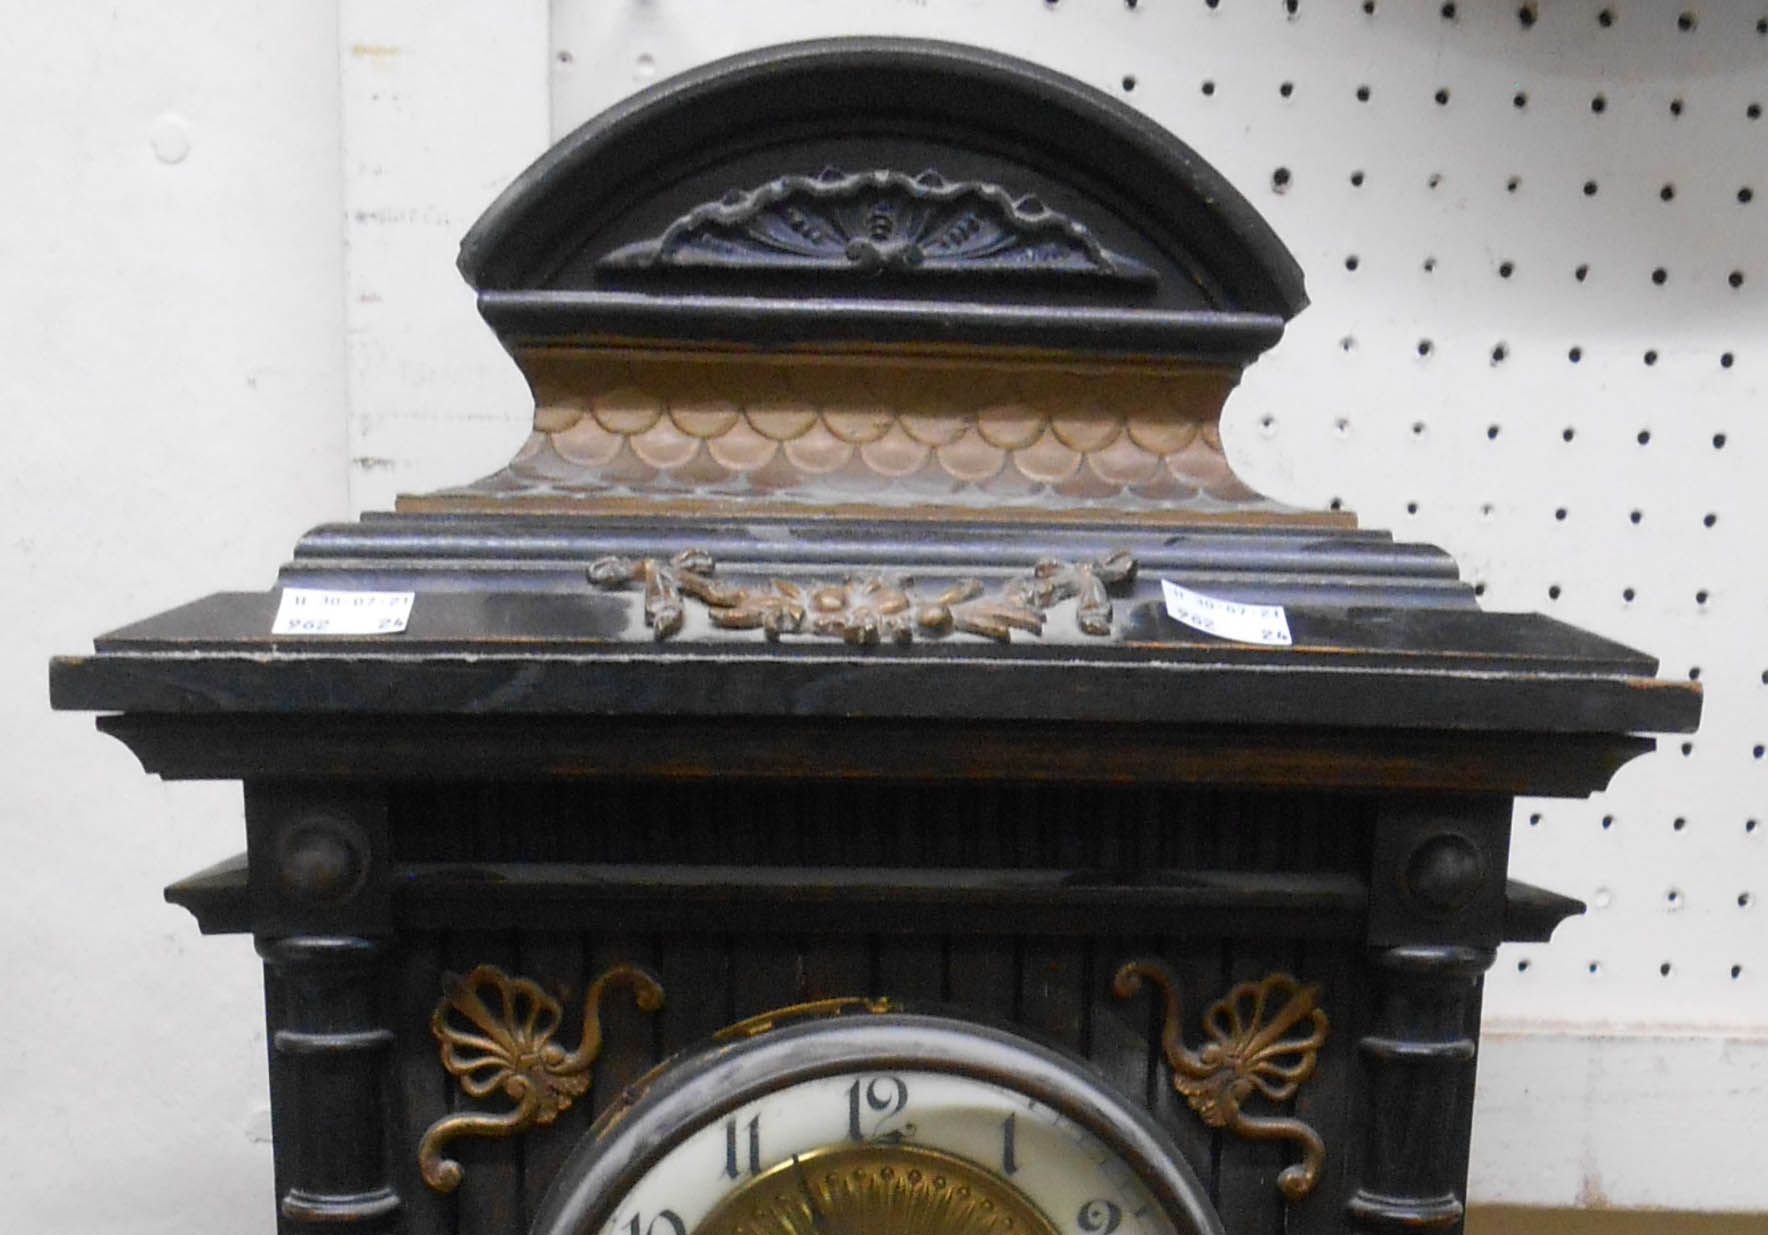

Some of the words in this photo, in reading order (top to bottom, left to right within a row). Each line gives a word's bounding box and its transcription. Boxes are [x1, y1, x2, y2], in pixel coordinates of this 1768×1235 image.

[845, 1076, 916, 1145] 12
[1002, 1111, 1018, 1177] 1
[721, 1112, 761, 1180] 11
